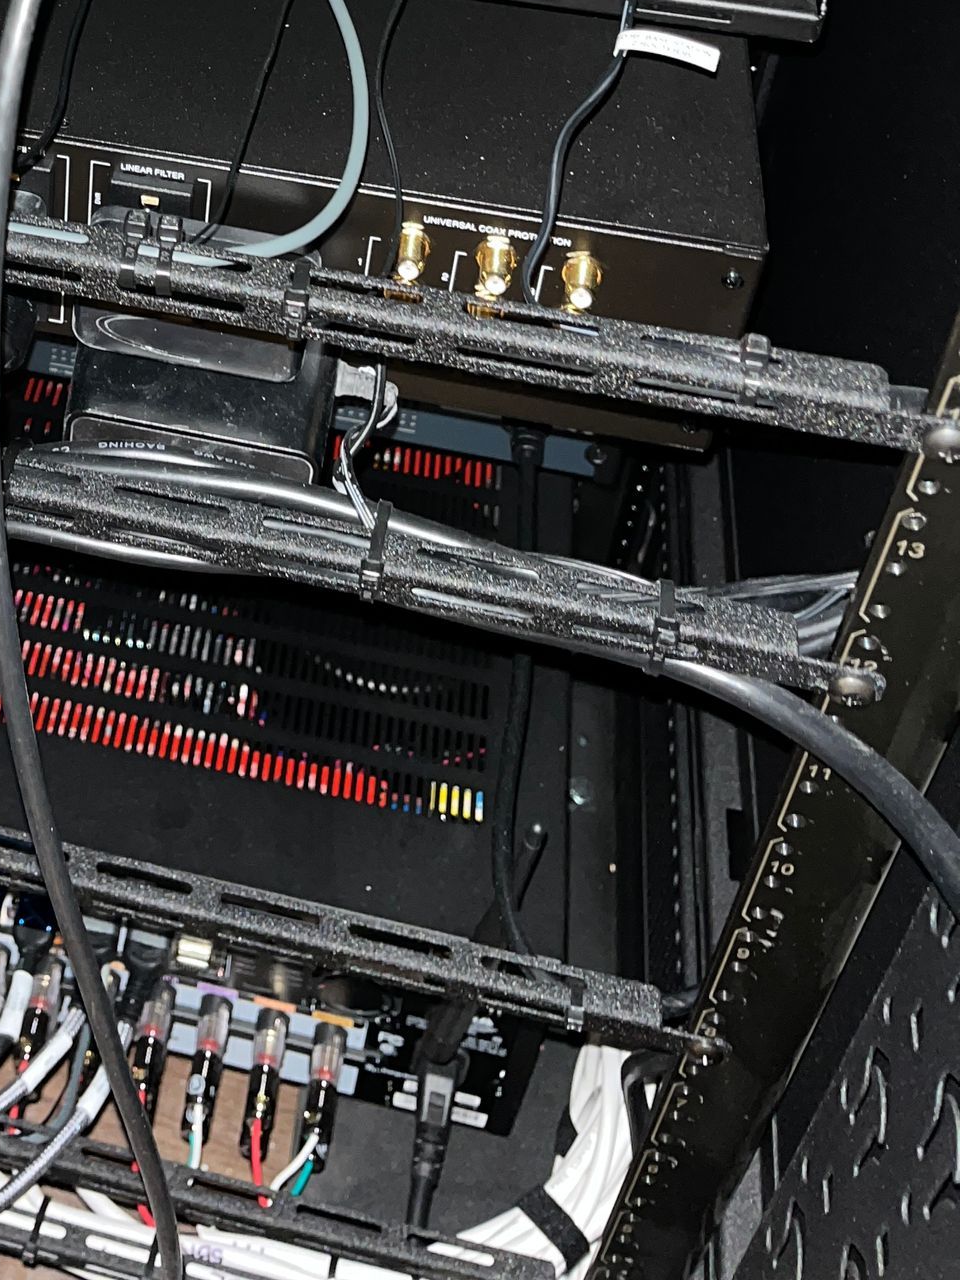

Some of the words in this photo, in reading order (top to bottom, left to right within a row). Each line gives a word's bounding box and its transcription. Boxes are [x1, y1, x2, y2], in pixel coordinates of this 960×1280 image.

[120, 162, 152, 177] LINEAR
[153, 166, 185, 181] FILTER
[423, 214, 477, 233] UNIVERSAL
[478, 223, 506, 237] COAX
[440, 272, 449, 282] 2
[97, 440, 164, 450] BAOHING
[895, 539, 926, 560] 13
[808, 765, 832, 781] 11
[770, 860, 795, 876] 10
[737, 947, 750, 960] 9
